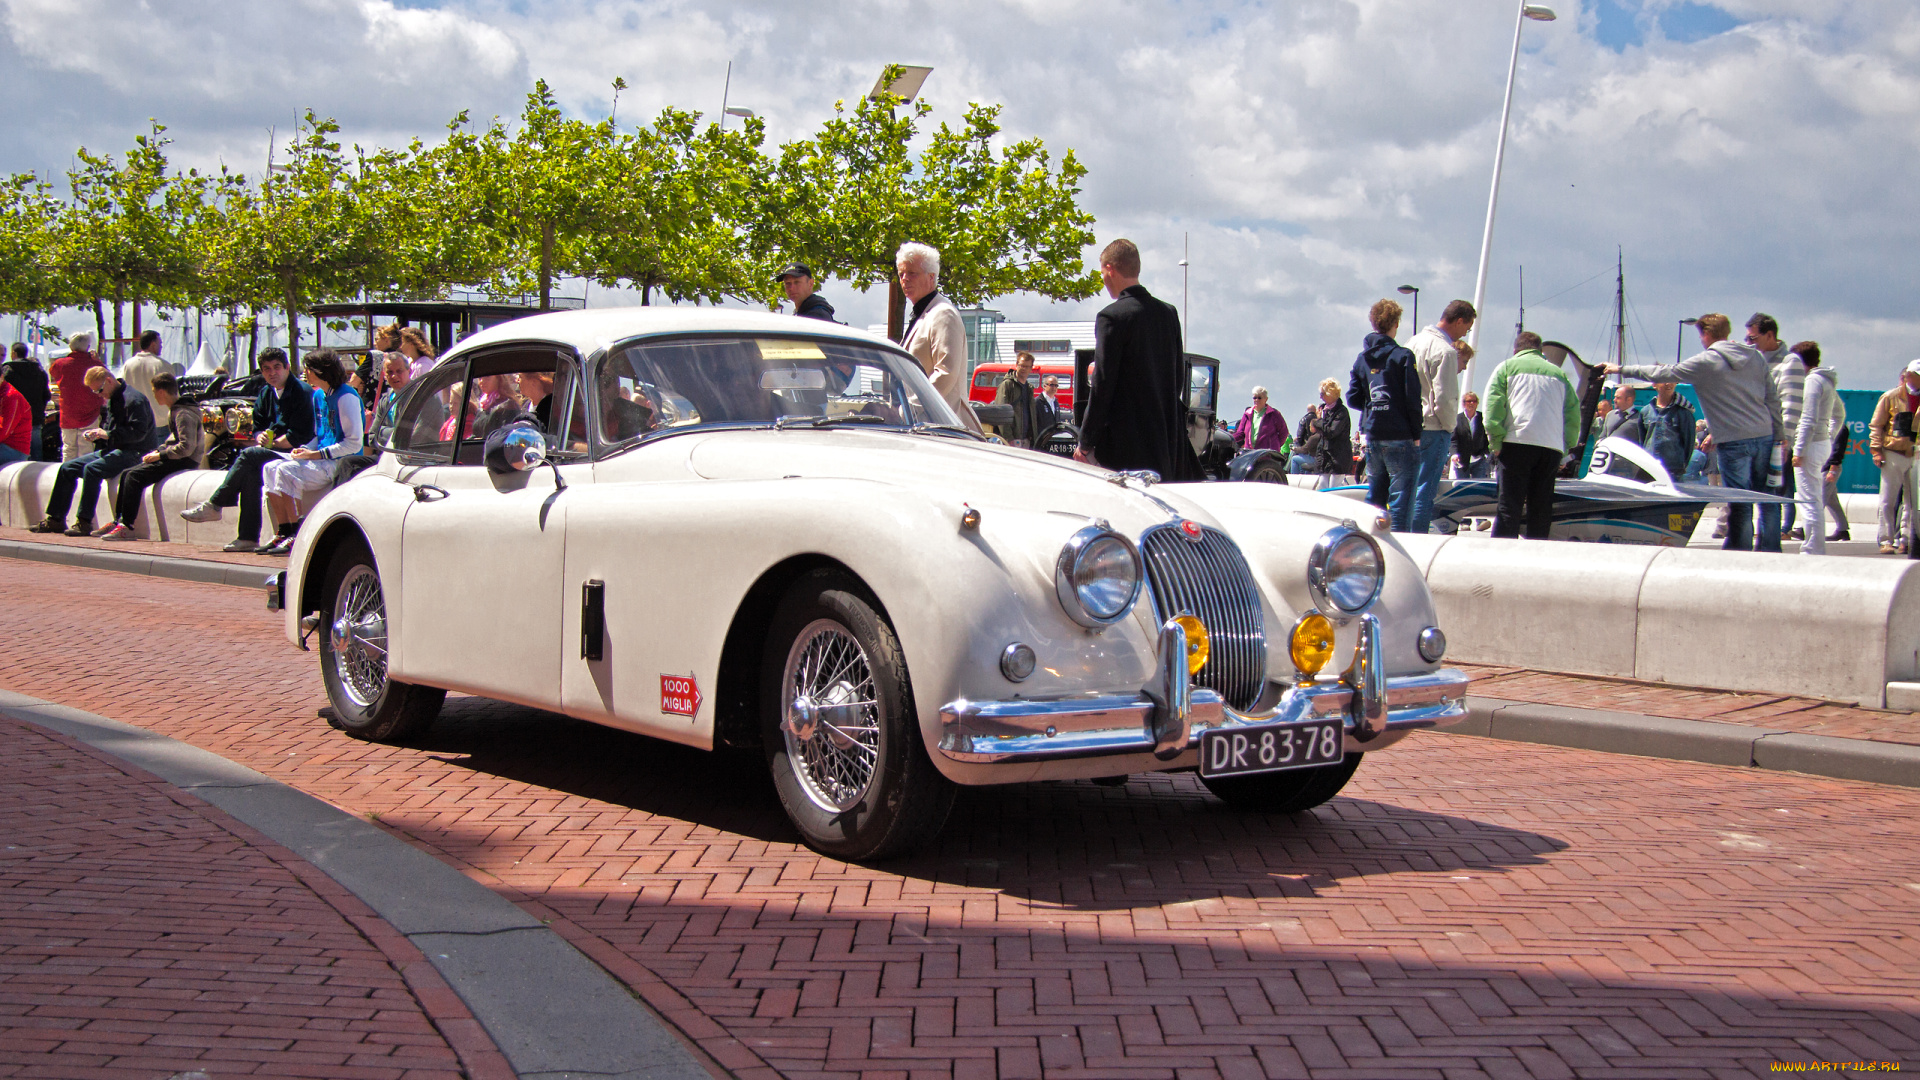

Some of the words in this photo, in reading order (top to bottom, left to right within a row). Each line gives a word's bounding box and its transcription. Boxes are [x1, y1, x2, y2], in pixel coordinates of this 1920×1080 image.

[1591, 451, 1609, 468] 3
[664, 679, 690, 694] 1000
[663, 696, 692, 711] MIGLIA
[1211, 725, 1336, 770] DR-83-78
